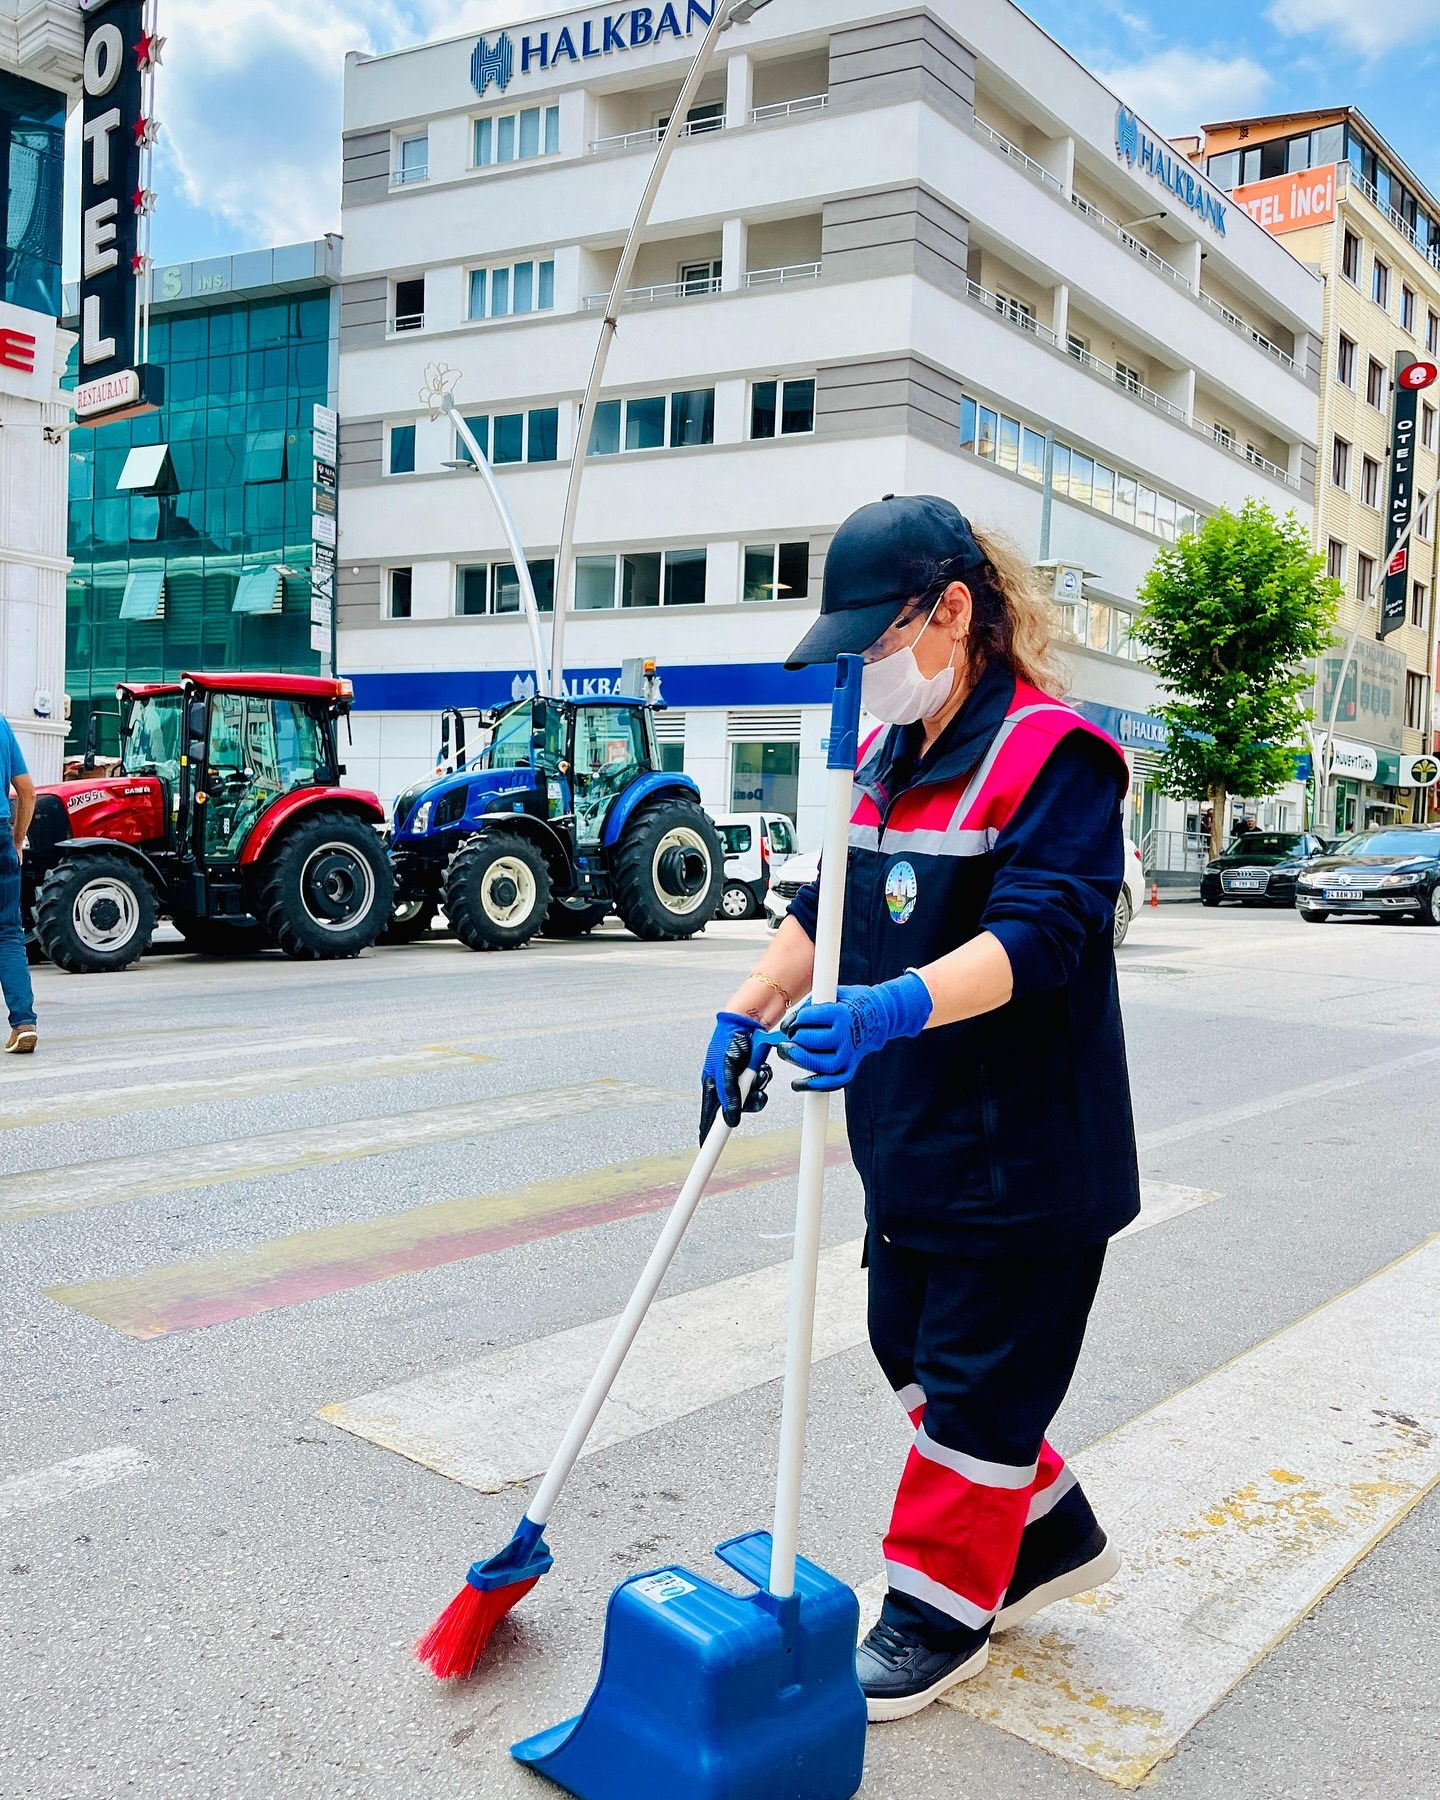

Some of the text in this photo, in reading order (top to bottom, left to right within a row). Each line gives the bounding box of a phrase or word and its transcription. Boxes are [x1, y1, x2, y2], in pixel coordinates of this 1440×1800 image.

[521, 0, 716, 73] HALKBAN
[83, 23, 123, 365] OTEL
[1139, 136, 1228, 238] HALKBANK
[1237, 174, 1332, 227] TEL İNCİ
[77, 375, 130, 410] RESTAURANT
[1396, 419, 1413, 473] OTEL
